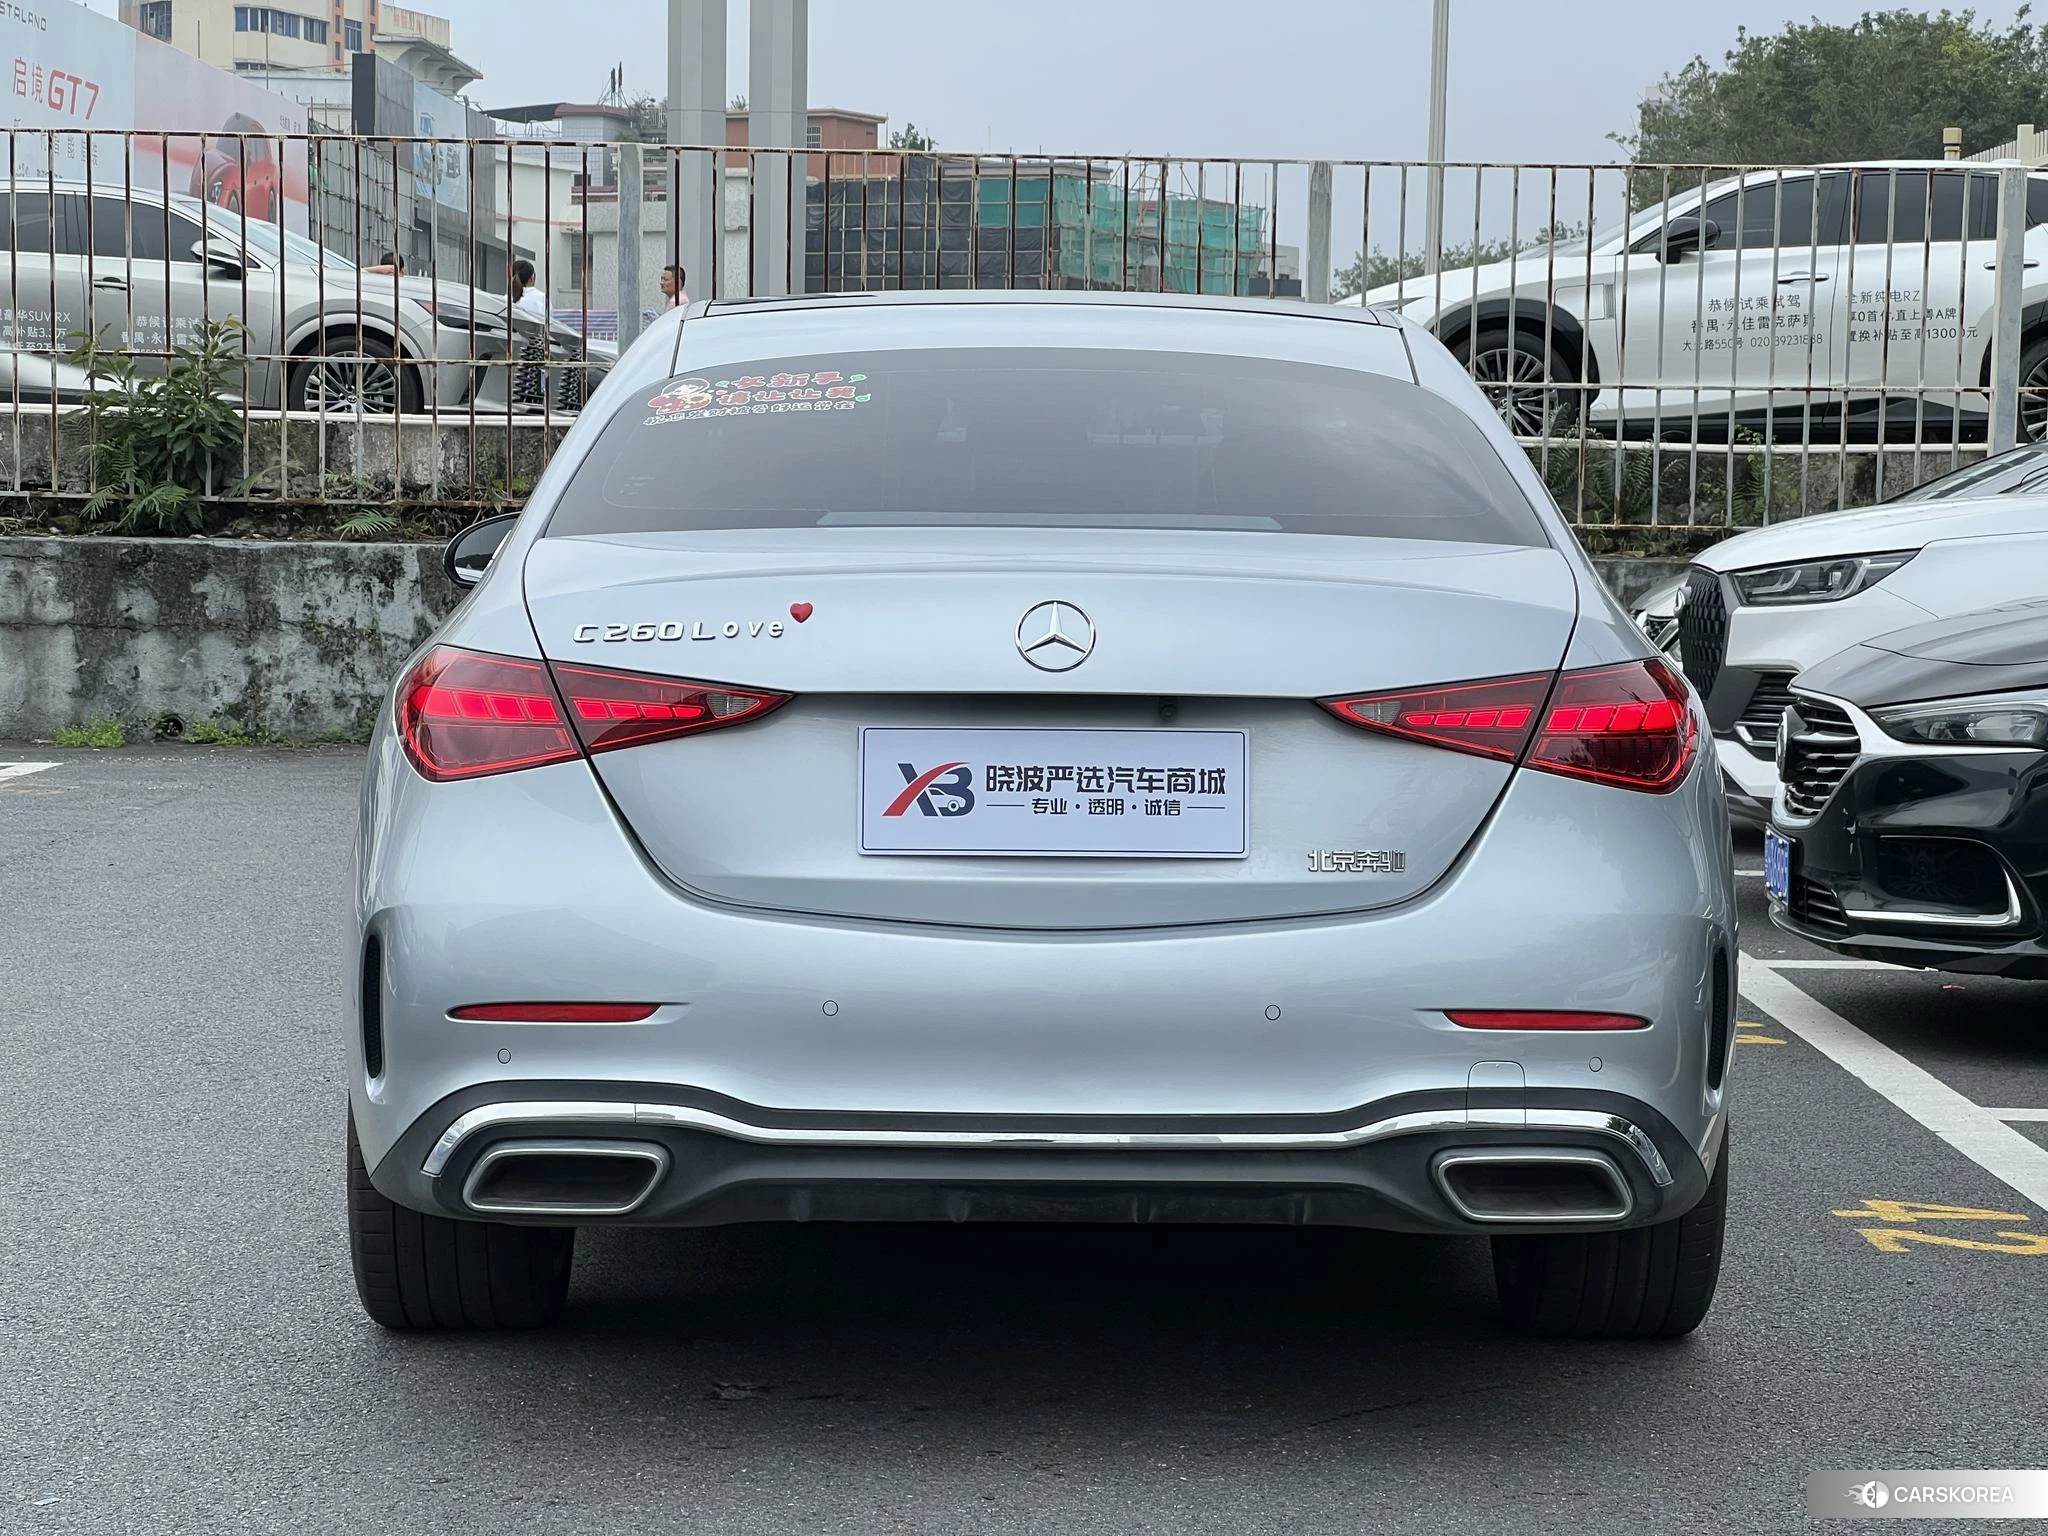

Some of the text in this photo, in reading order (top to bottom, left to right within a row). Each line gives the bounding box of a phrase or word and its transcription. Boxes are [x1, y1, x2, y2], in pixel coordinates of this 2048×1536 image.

[985, 764, 1227, 796] 晓波严选汽车商城
[1307, 849, 1406, 873] 北京奔驰
